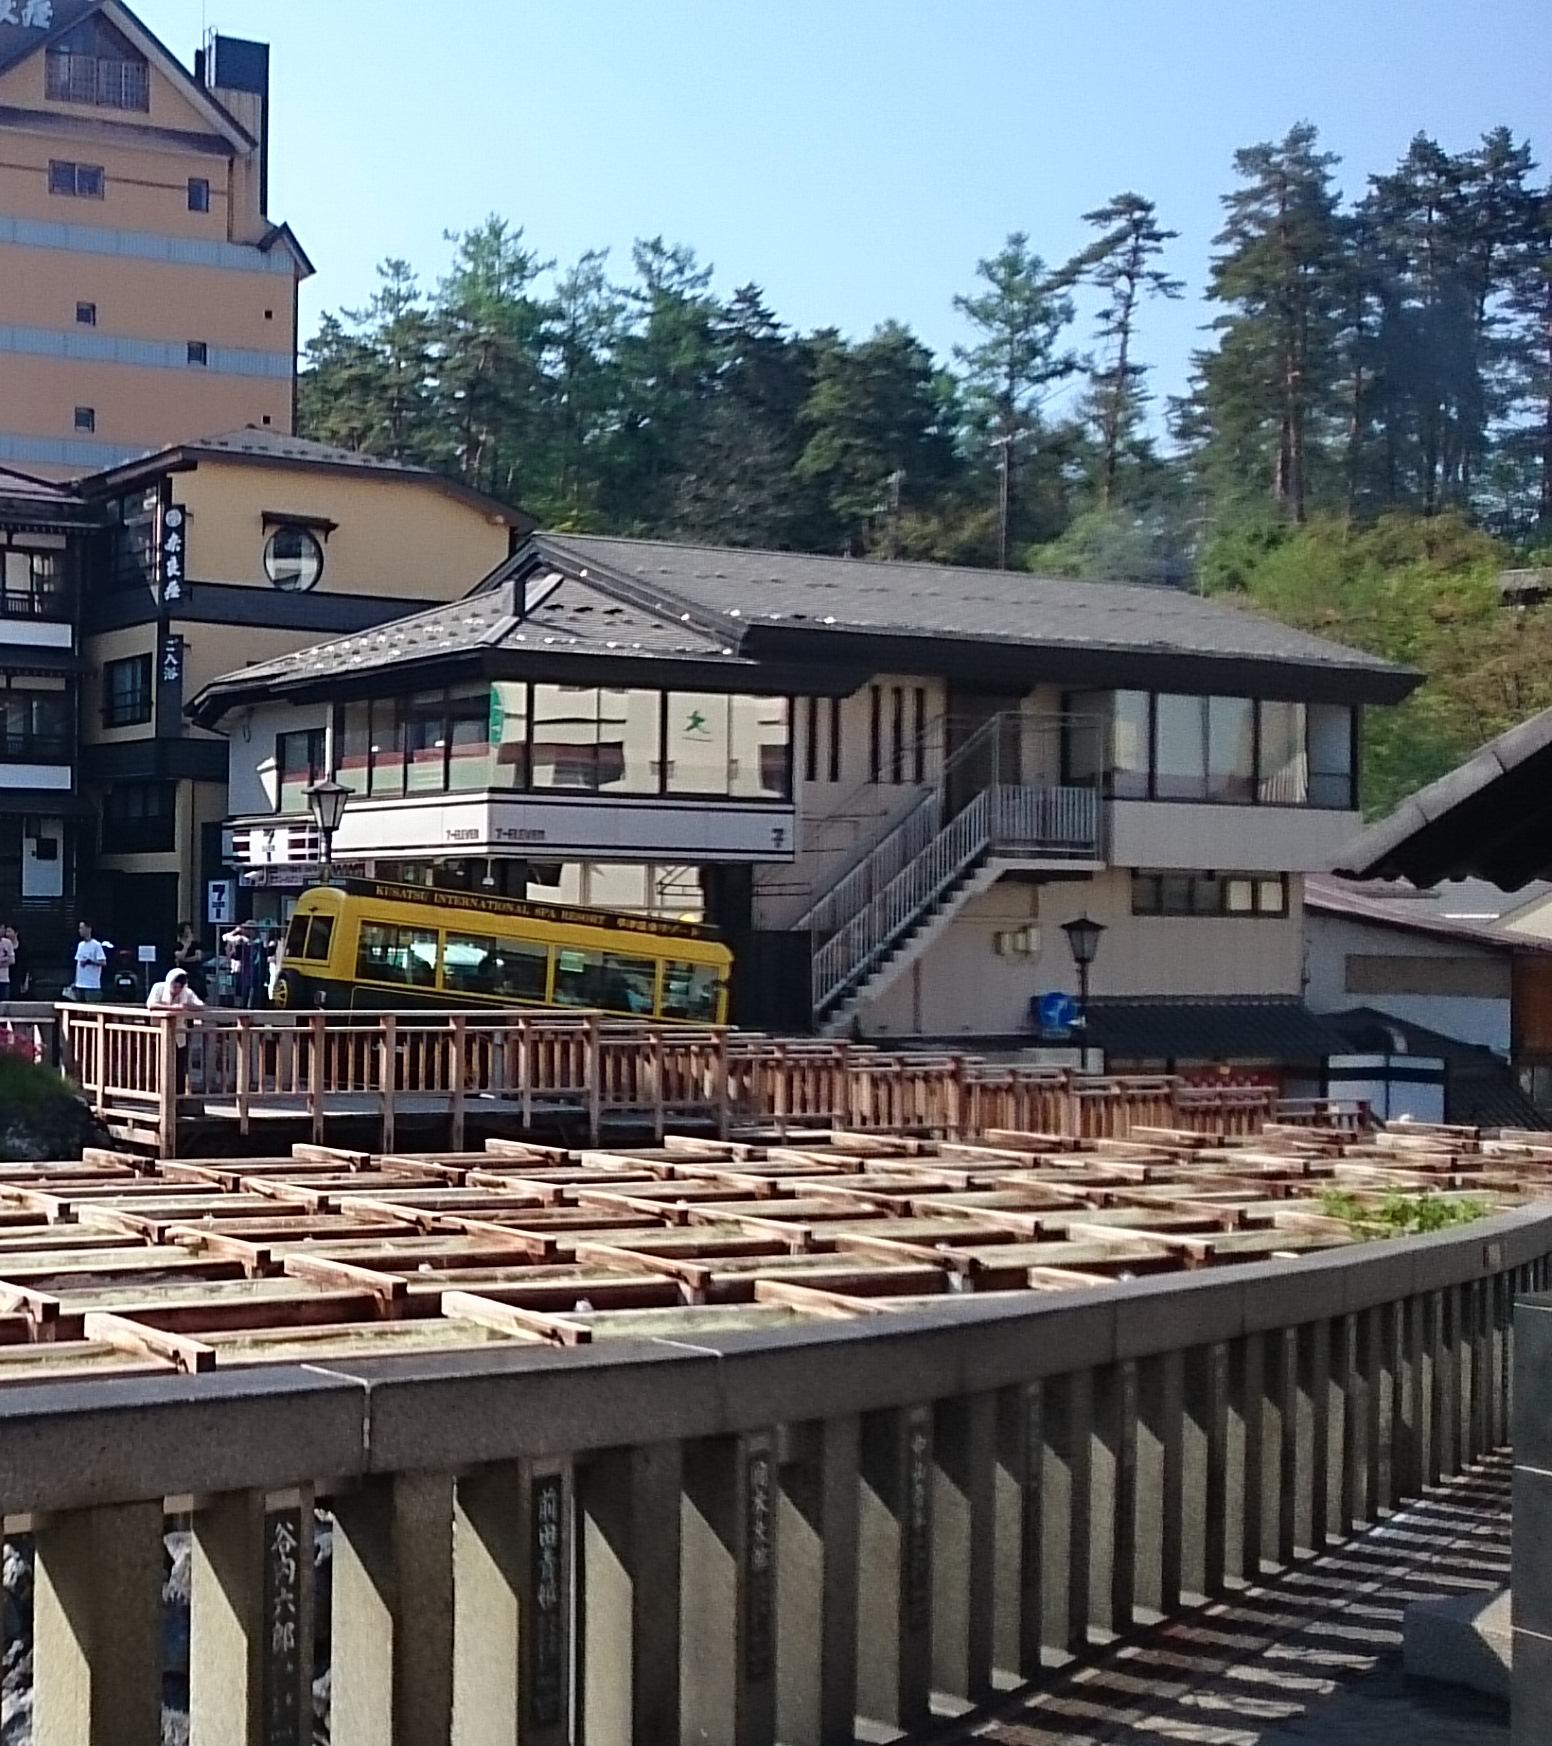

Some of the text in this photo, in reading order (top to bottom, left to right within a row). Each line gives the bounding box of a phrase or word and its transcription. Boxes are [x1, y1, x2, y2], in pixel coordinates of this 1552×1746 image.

[376, 885, 427, 900] KUSATSU
[434, 892, 530, 915] INTERNATIONAL
[535, 905, 556, 919] SPA
